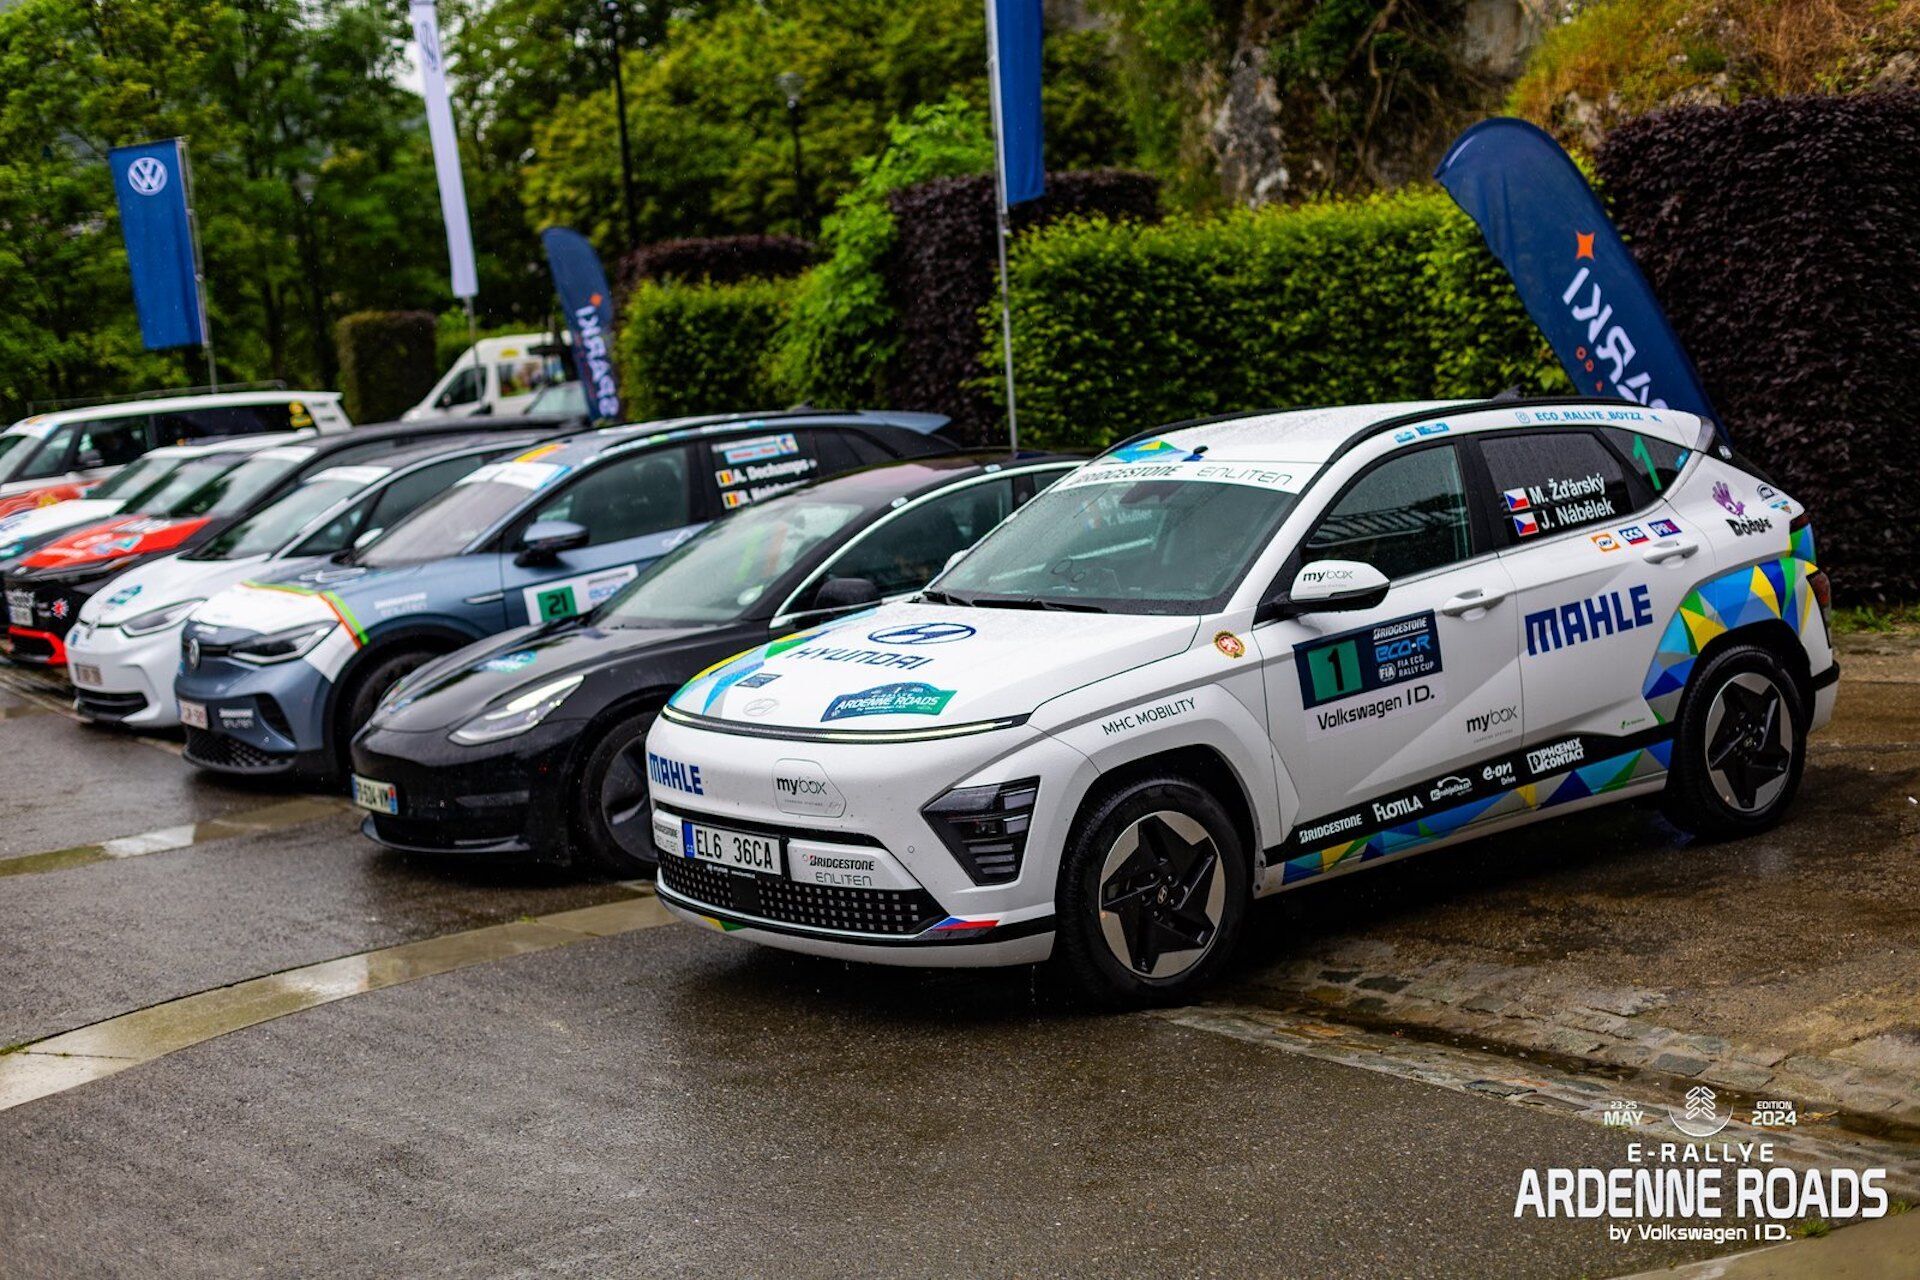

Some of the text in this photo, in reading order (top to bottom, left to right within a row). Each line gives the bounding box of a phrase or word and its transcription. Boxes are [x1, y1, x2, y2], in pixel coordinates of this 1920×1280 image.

[1197, 466, 1293, 485] ENLITEN
[1632, 434, 1661, 491] 1
[1528, 472, 1606, 505] M. Žďárský
[1541, 497, 1616, 530] J. Nábělek
[546, 593, 568, 615] 21
[1373, 616, 1428, 641] BRIDGESTONE
[1524, 584, 1653, 657] MAHLE
[786, 647, 935, 670] HYUNDAI
[1327, 648, 1345, 691] 1
[1397, 654, 1425, 668] FIA ECO
[1398, 660, 1435, 678] RALLY CUP
[835, 697, 893, 711] ARDENNE
[893, 696, 941, 708] ROADS
[1102, 697, 1197, 736] MHC MOBILITY
[1317, 685, 1436, 731] Volkswagen ID.
[1543, 747, 1585, 770] CONTACT
[648, 752, 704, 796] MAHLE
[1372, 795, 1424, 823] FLOTILA
[1299, 813, 1363, 845] BRIDGESTONE
[694, 828, 773, 870] EL6 36CA
[809, 855, 875, 871] BRIDGESTONE
[815, 871, 873, 887] ENLITEN
